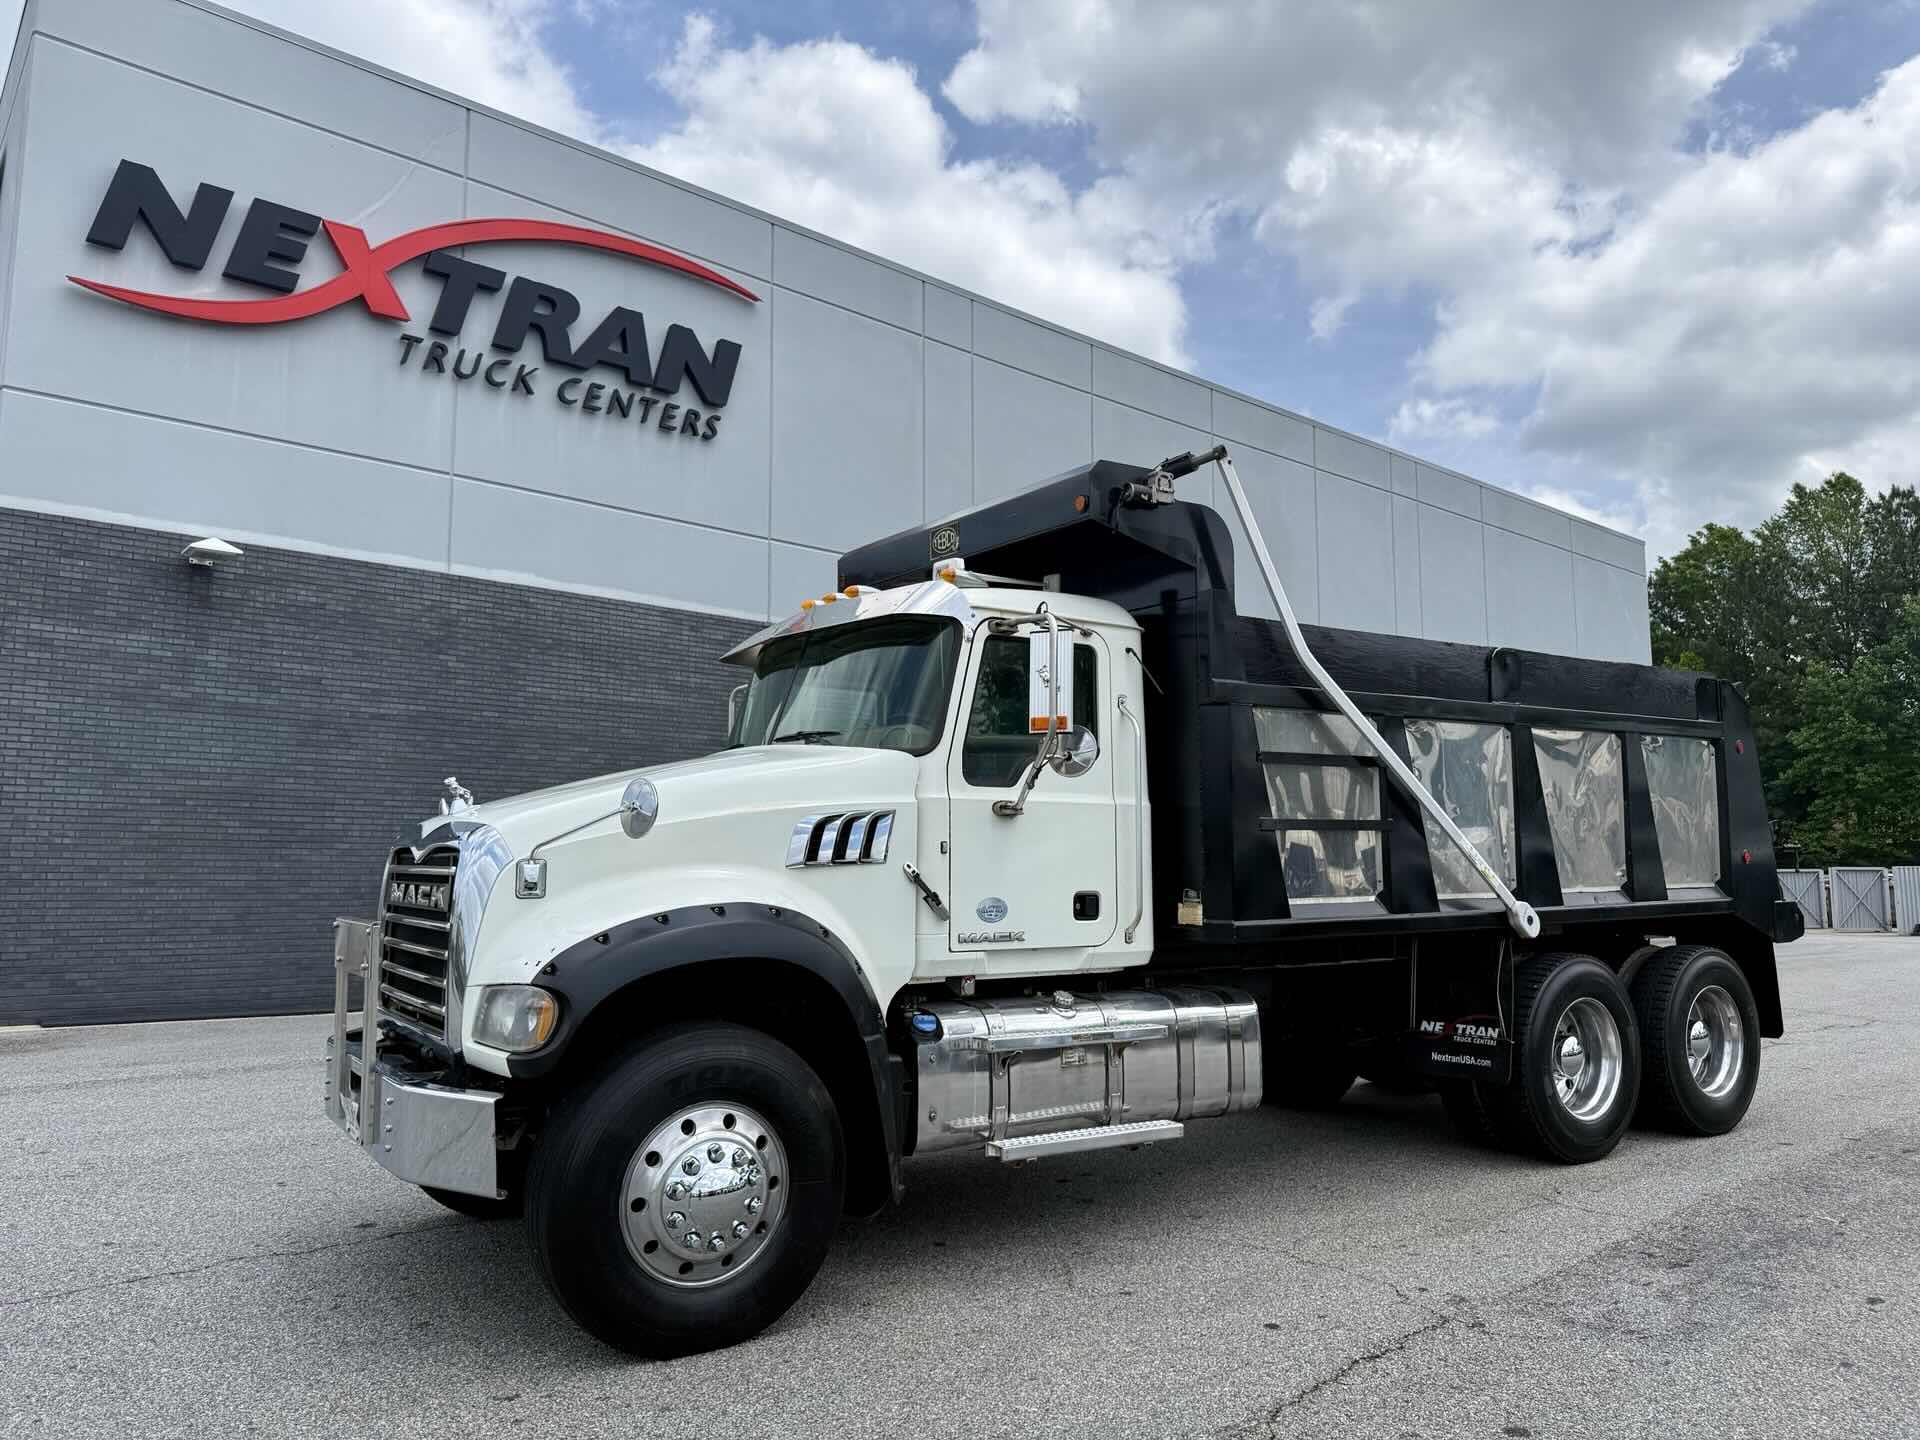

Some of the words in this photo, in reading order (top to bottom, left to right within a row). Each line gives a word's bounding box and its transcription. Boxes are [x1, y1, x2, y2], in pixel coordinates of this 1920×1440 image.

[85, 158, 744, 408] NEXTRAN
[399, 333, 540, 396] TRUCK
[556, 377, 722, 441] CENTERS
[391, 882, 447, 908] MACK
[957, 931, 1026, 944] MACK
[1453, 1035, 1472, 1043] TRUCK
[1473, 1038, 1497, 1046] CENTERS
[1431, 1051, 1492, 1067] NextranUSA.com
